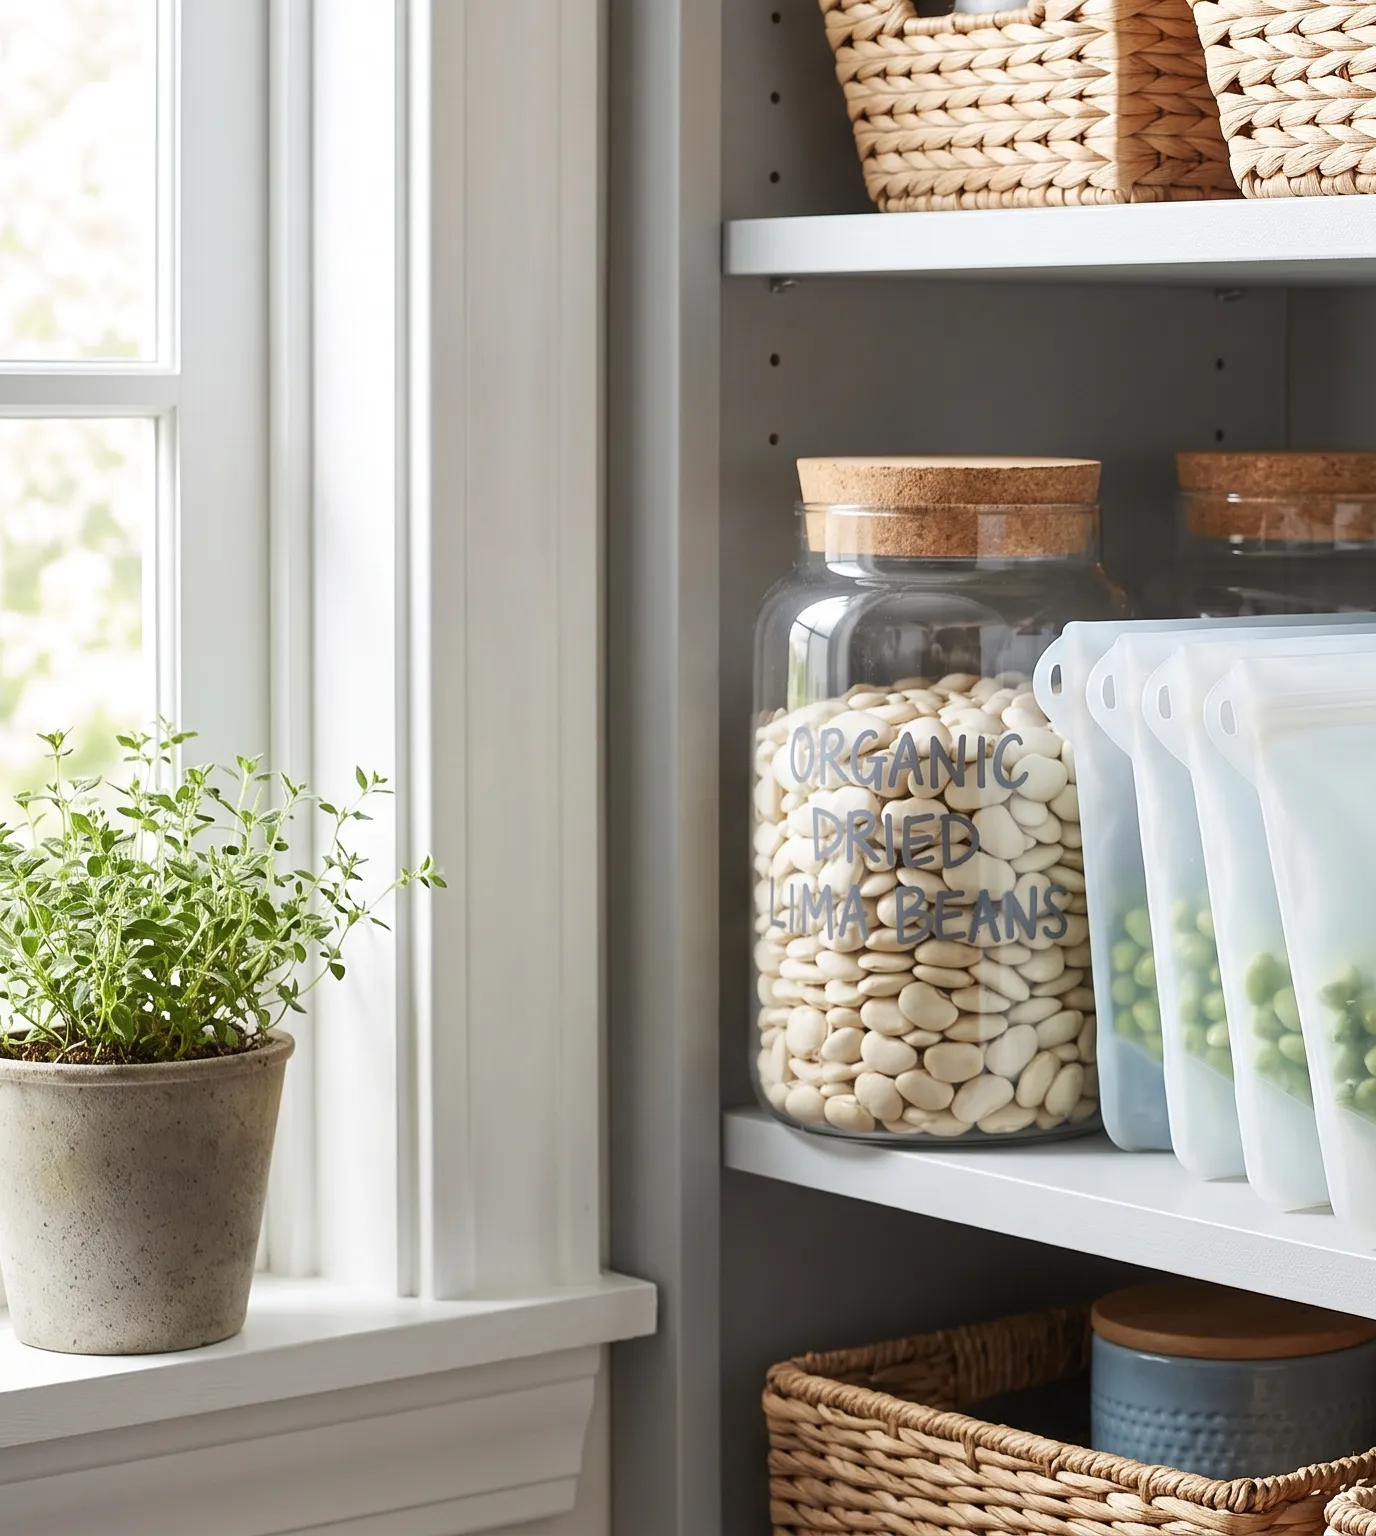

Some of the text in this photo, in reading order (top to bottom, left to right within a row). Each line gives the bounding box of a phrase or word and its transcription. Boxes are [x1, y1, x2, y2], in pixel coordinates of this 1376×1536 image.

[789, 726, 1030, 790] ORGANIC
[812, 806, 981, 869] DRIED
[769, 876, 1070, 945] LIMA BEANS
